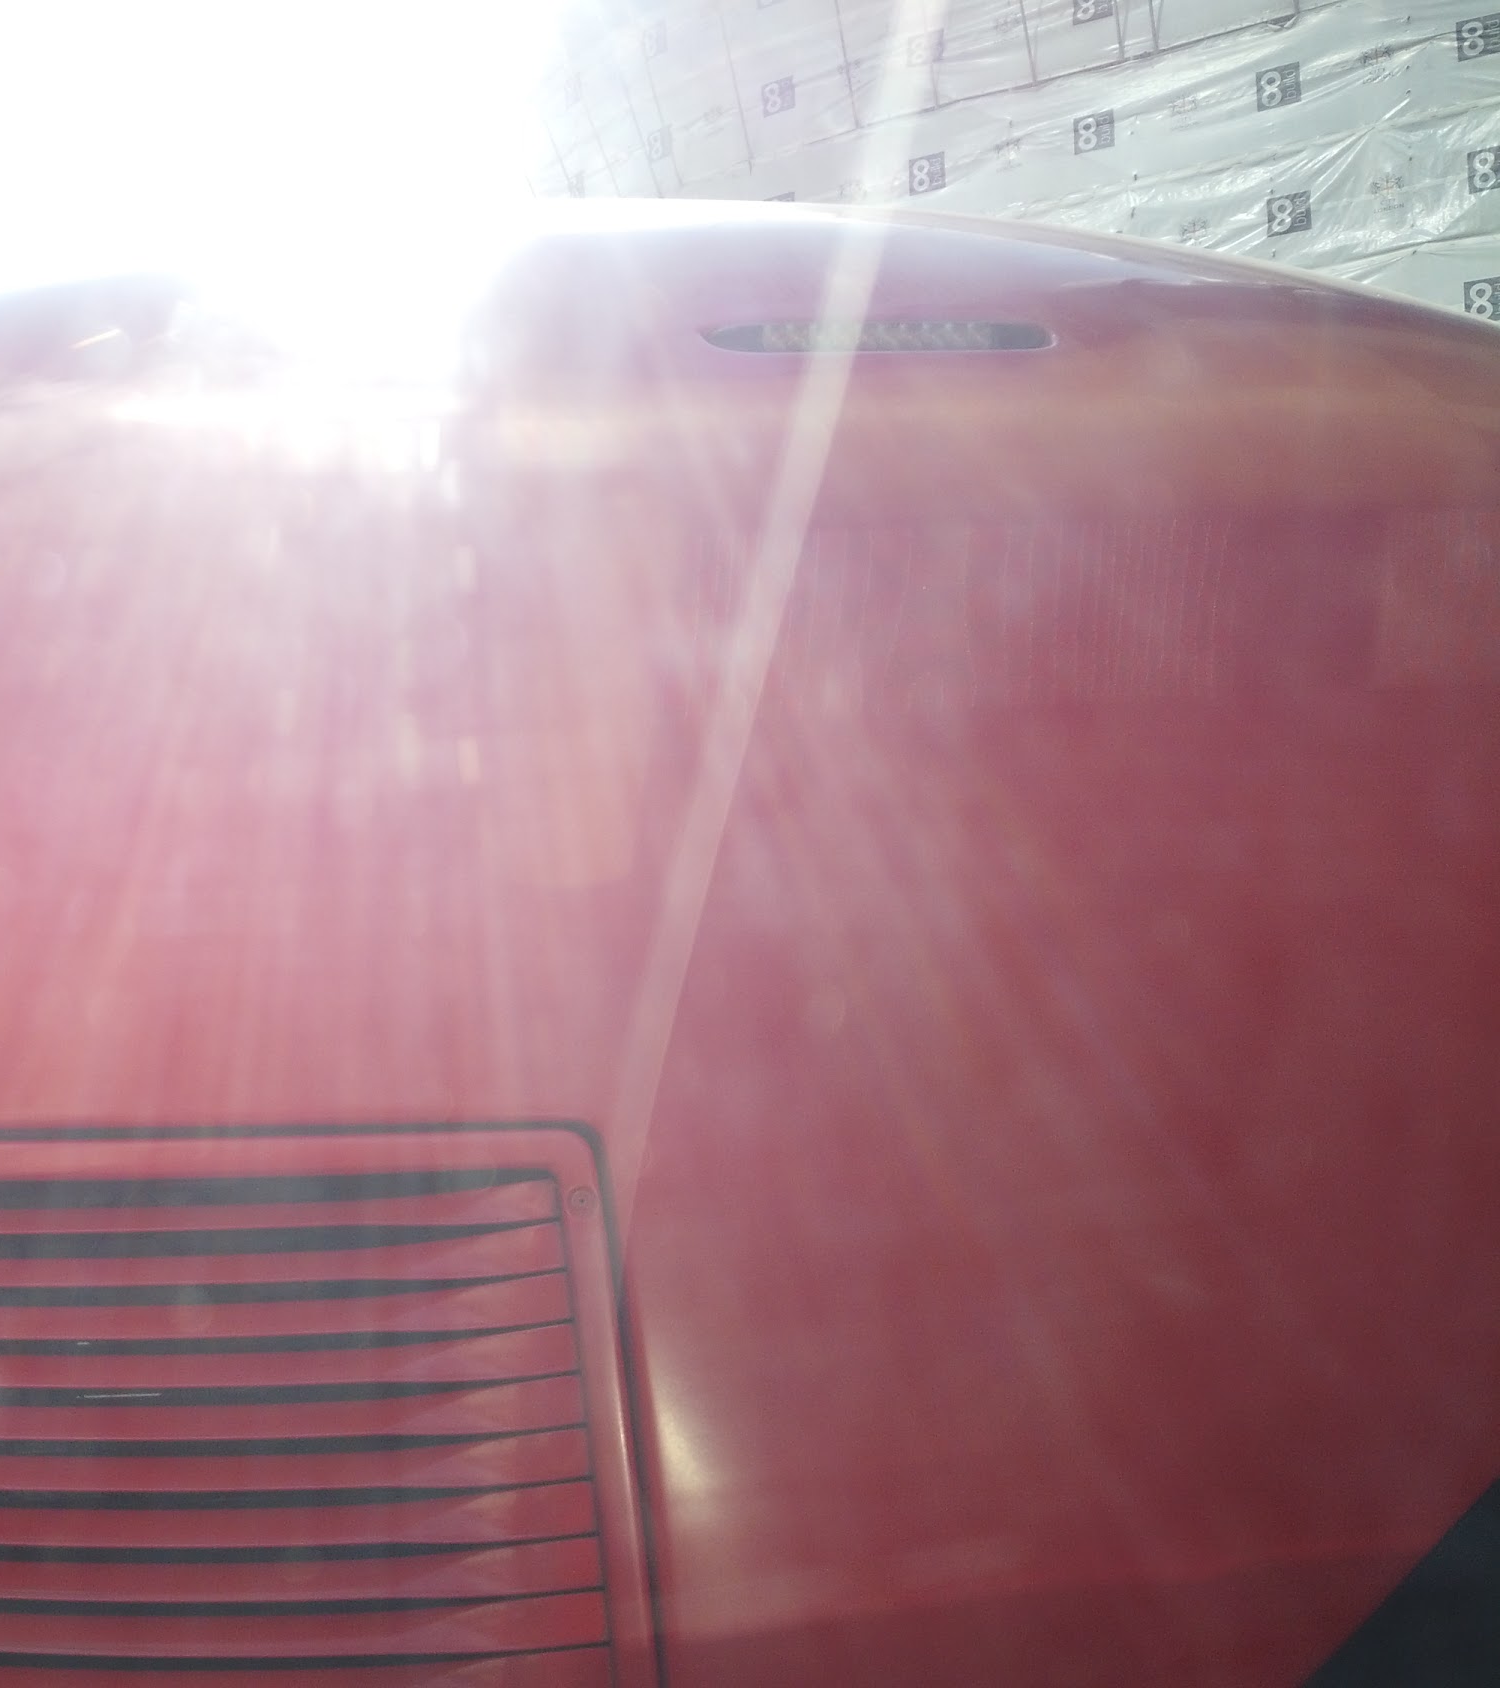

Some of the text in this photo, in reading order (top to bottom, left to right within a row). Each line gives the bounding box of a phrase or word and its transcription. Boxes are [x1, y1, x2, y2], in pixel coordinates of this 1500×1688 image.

[1461, 21, 1484, 56] 8
[765, 83, 781, 113] 8
[1260, 69, 1297, 107] 8 build
[1079, 117, 1097, 150] 8
[913, 159, 930, 192] 8
[1472, 151, 1496, 189] 8
[1271, 198, 1293, 233] 8
[1470, 282, 1494, 319] 8
